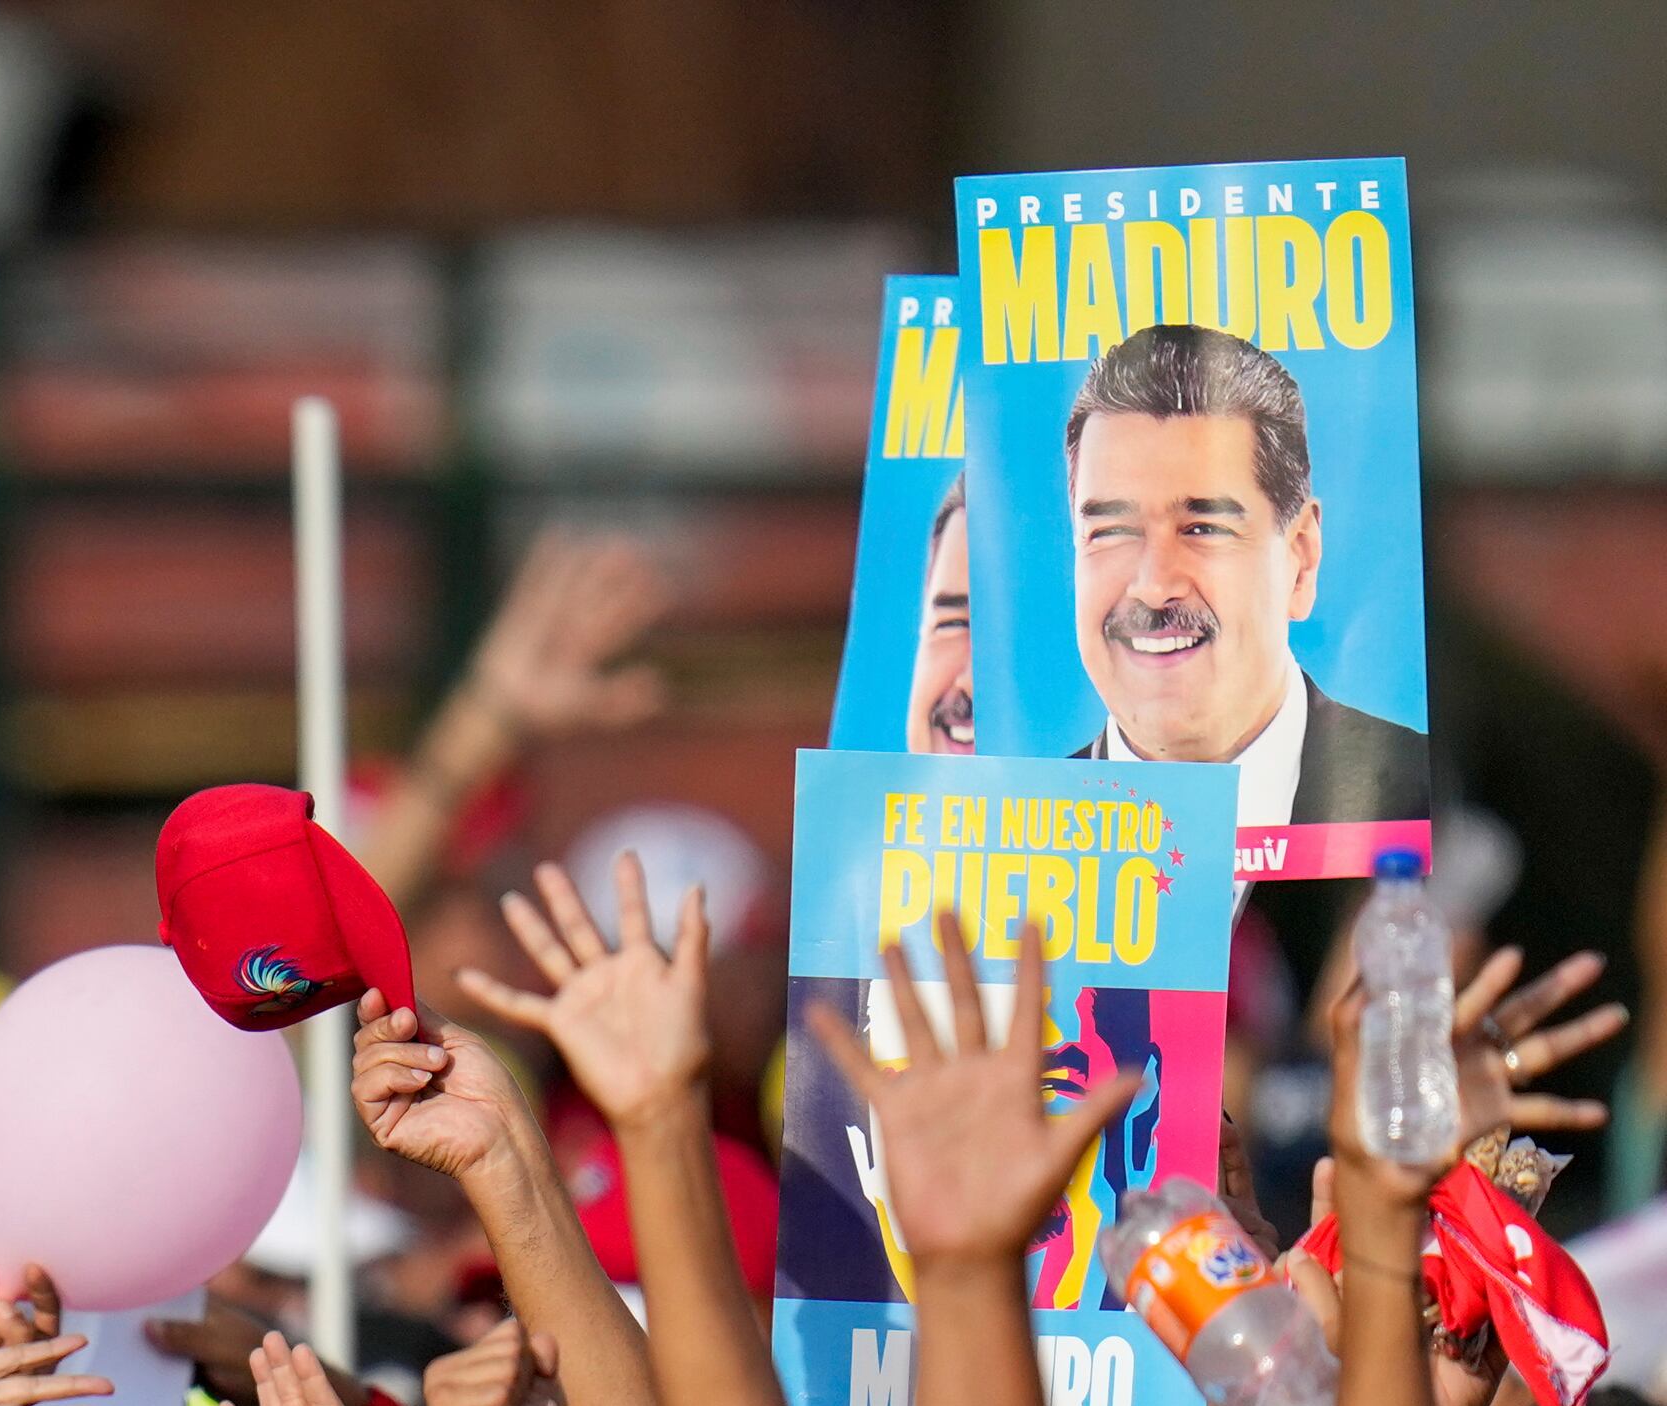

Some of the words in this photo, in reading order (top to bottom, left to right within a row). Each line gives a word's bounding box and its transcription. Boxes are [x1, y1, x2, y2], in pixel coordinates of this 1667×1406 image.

[976, 180, 1381, 227] PRESIDENTE
[978, 210, 1392, 365] MADURO
[884, 792, 926, 844] FE
[941, 795, 987, 846] EN
[1001, 797, 1163, 856] NUESTRO
[878, 848, 1159, 966] PUEBLO
